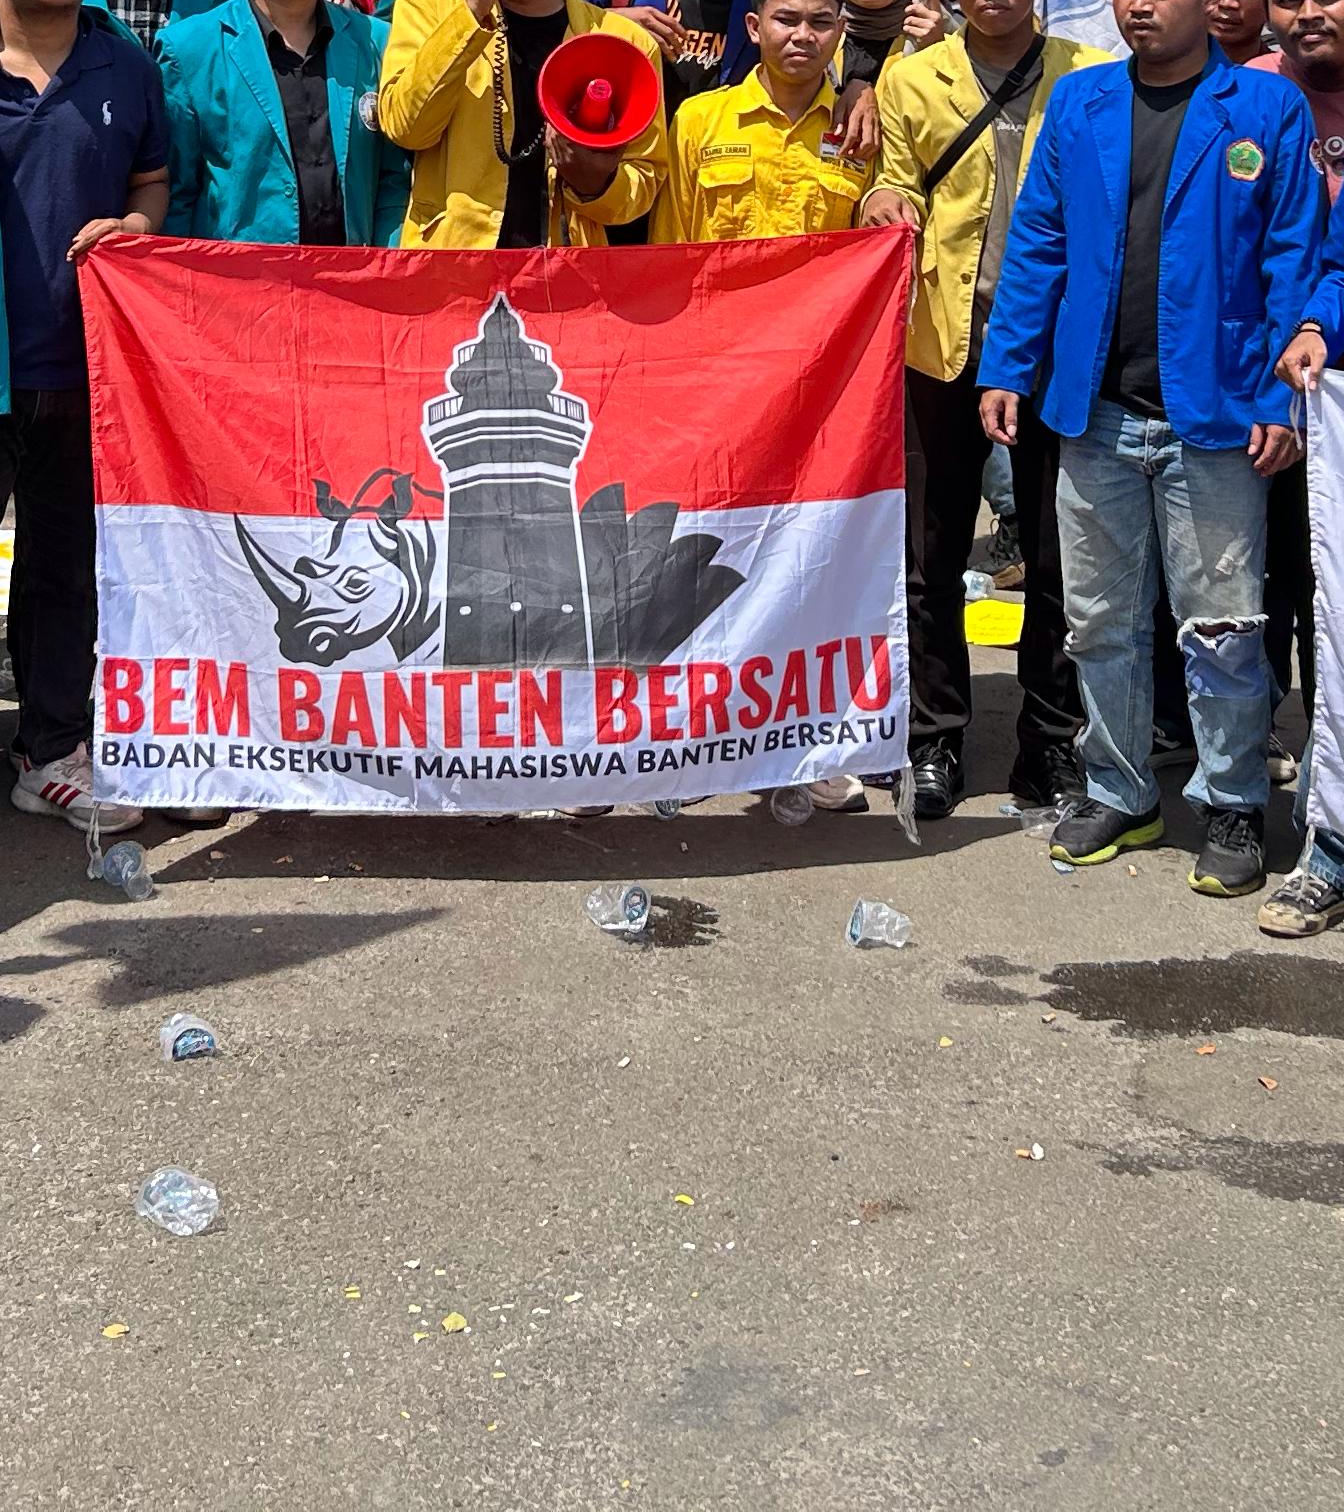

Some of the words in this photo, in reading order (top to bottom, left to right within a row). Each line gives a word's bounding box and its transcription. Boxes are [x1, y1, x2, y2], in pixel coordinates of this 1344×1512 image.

[102, 656, 250, 738] BEM
[278, 667, 563, 750] BANTEN
[594, 634, 892, 745] BERSATU
[102, 741, 215, 769] BADAN
[228, 744, 404, 776] EKSEKUTIF
[415, 751, 626, 780] MAHASISWA
[637, 735, 758, 774] BANTEN
[764, 715, 896, 752] BERSATU
